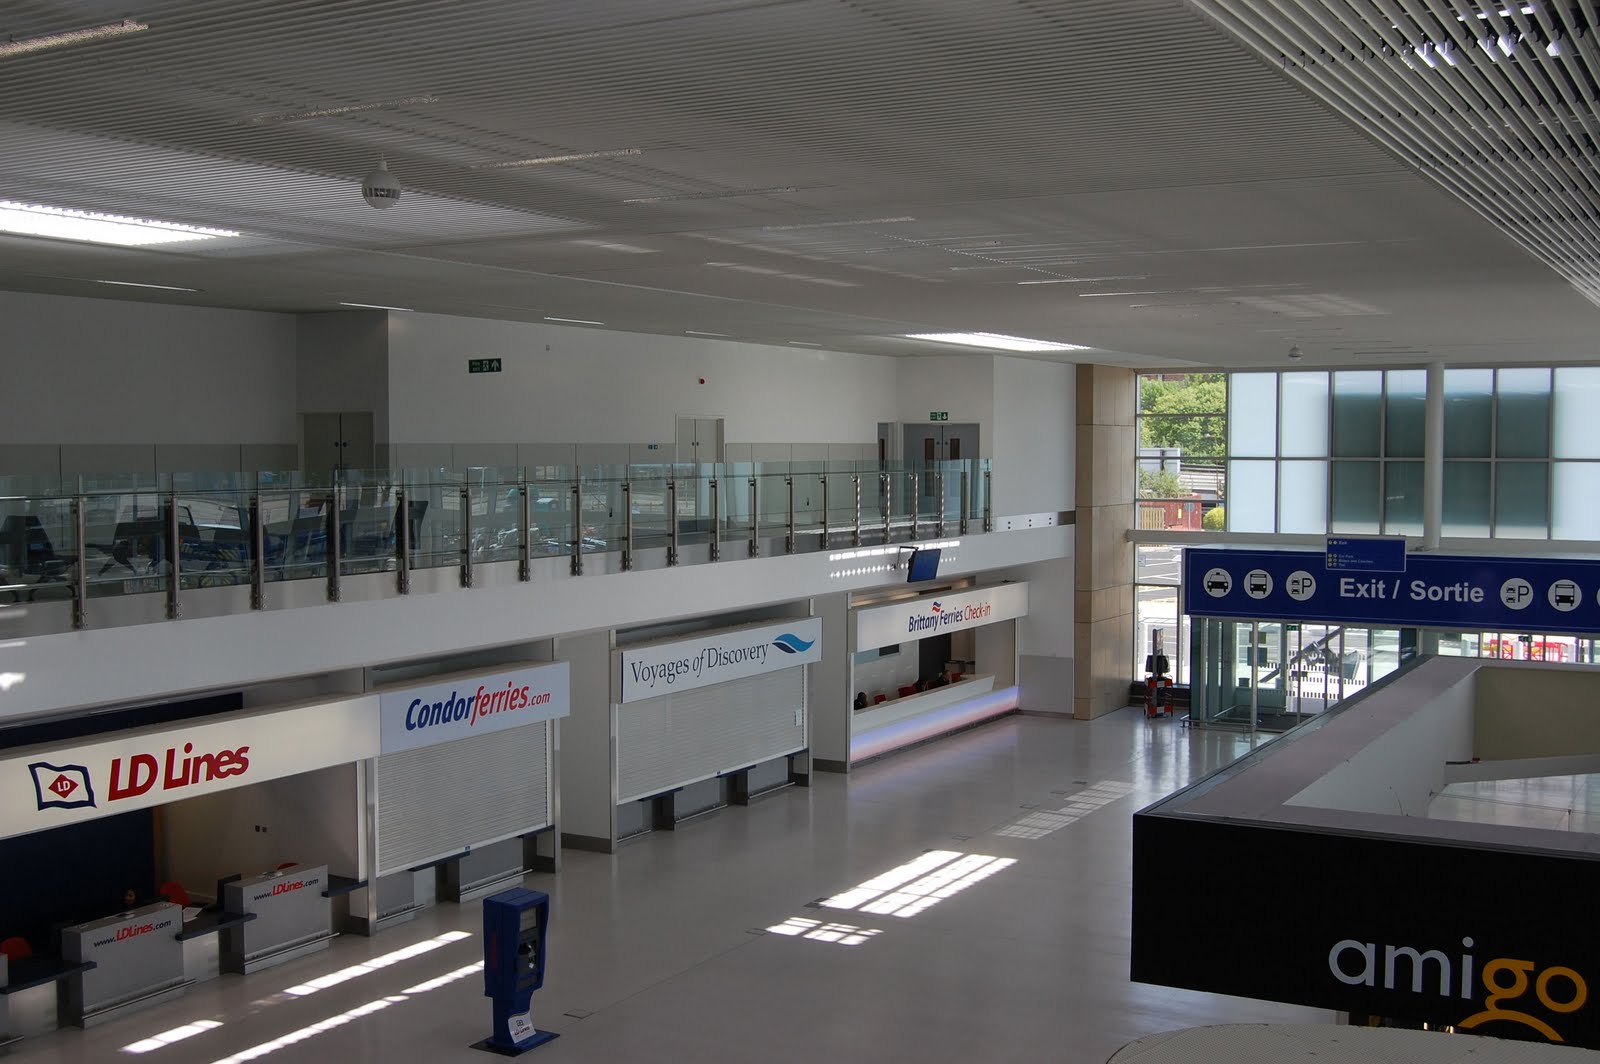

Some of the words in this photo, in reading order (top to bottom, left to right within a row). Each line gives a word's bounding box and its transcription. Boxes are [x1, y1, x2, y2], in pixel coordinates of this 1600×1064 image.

[1340, 577, 1386, 599] Exit
[1392, 579, 1401, 600] /
[1410, 580, 1484, 602] Sortie
[908, 614, 940, 632] Brittany
[939, 607, 964, 626] Ferries
[964, 602, 991, 621] Check-in
[630, 657, 690, 688] Voyages
[692, 648, 707, 678] of
[706, 643, 769, 669] Discovery
[405, 680, 551, 731] Condorferries.com
[57, 780, 71, 792] LD
[108, 753, 159, 801] LD
[163, 742, 250, 790] Lines
[253, 877, 319, 901] www.LDLines.com
[93, 919, 172, 948] www.LDLines.com
[1328, 936, 1588, 1041] amigo
